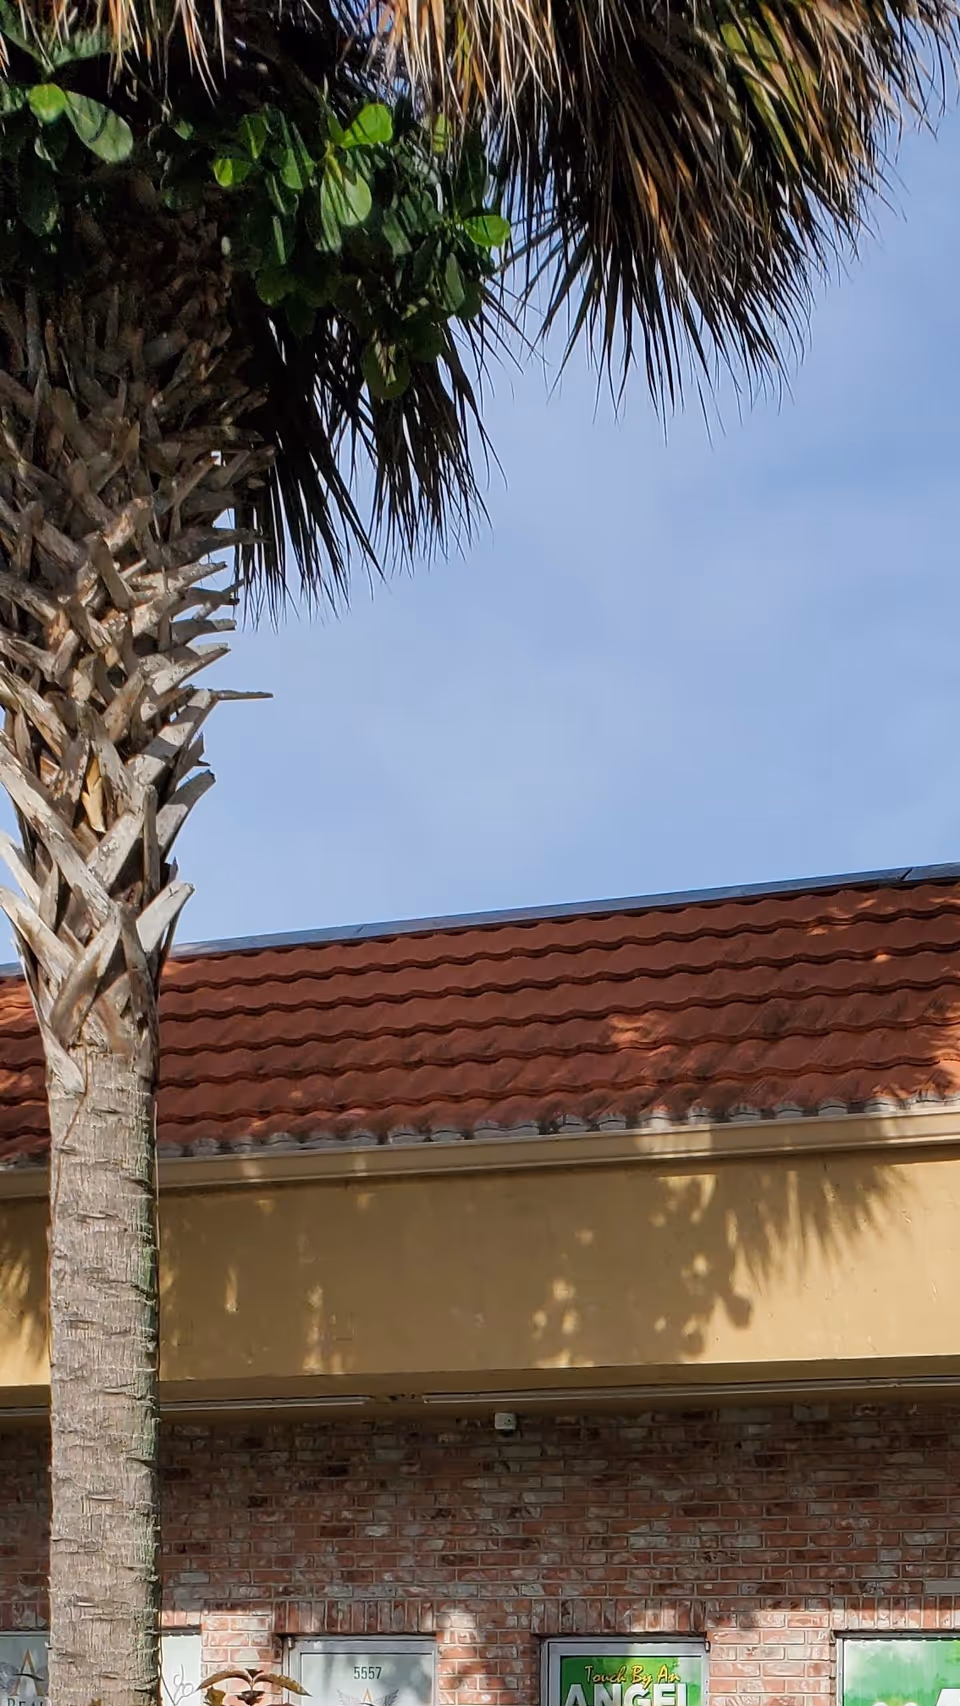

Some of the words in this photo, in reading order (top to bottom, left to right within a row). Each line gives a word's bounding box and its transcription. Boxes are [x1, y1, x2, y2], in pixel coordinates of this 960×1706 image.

[353, 1666, 382, 1680] 5557
[585, 1665, 626, 1683] Touch
[631, 1664, 652, 1691] By
[657, 1664, 681, 1683] An
